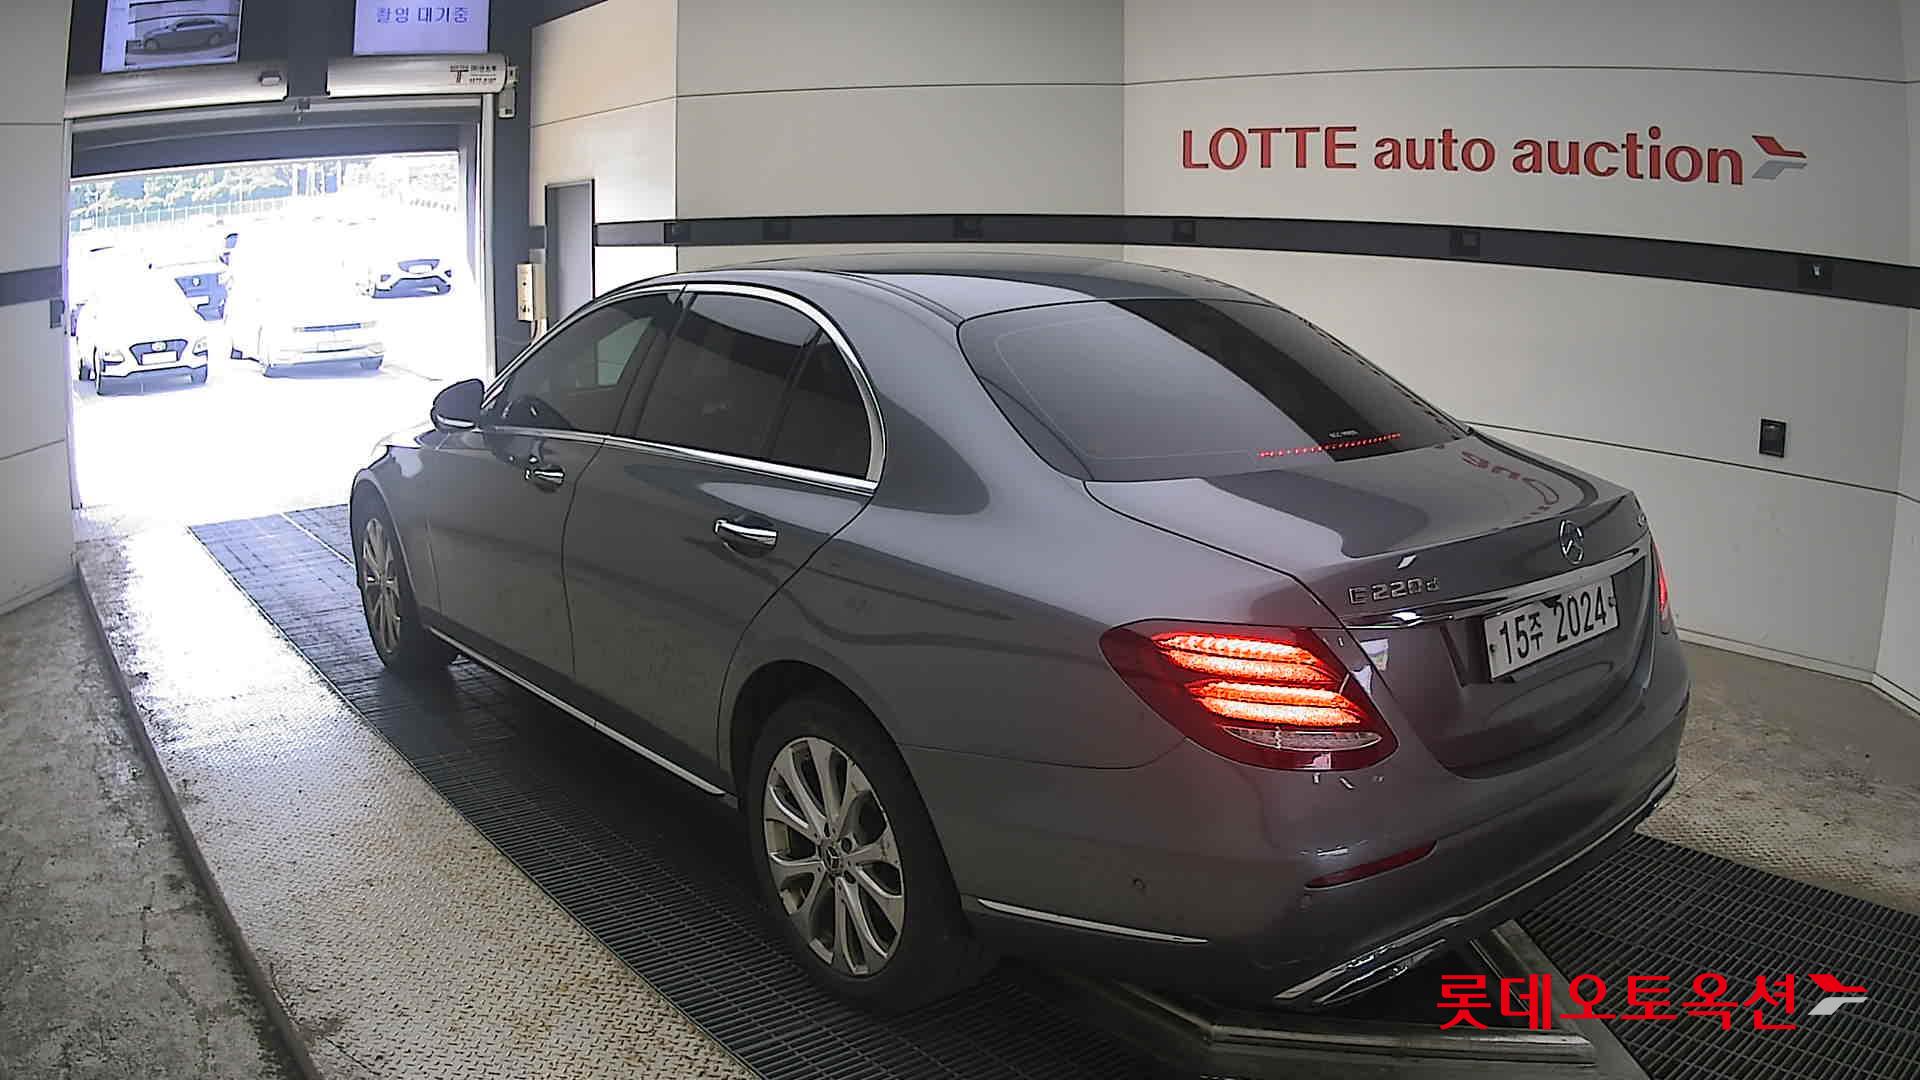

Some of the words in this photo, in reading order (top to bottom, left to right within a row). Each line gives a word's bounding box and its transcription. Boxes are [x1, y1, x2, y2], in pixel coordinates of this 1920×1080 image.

[417, 7, 471, 23] 대기중
[1182, 126, 1357, 170] LOTTE
[1374, 128, 1496, 172] auto
[1511, 126, 1744, 185] auction
[1500, 609, 1544, 665] 15주
[1553, 586, 1608, 643] 2024
